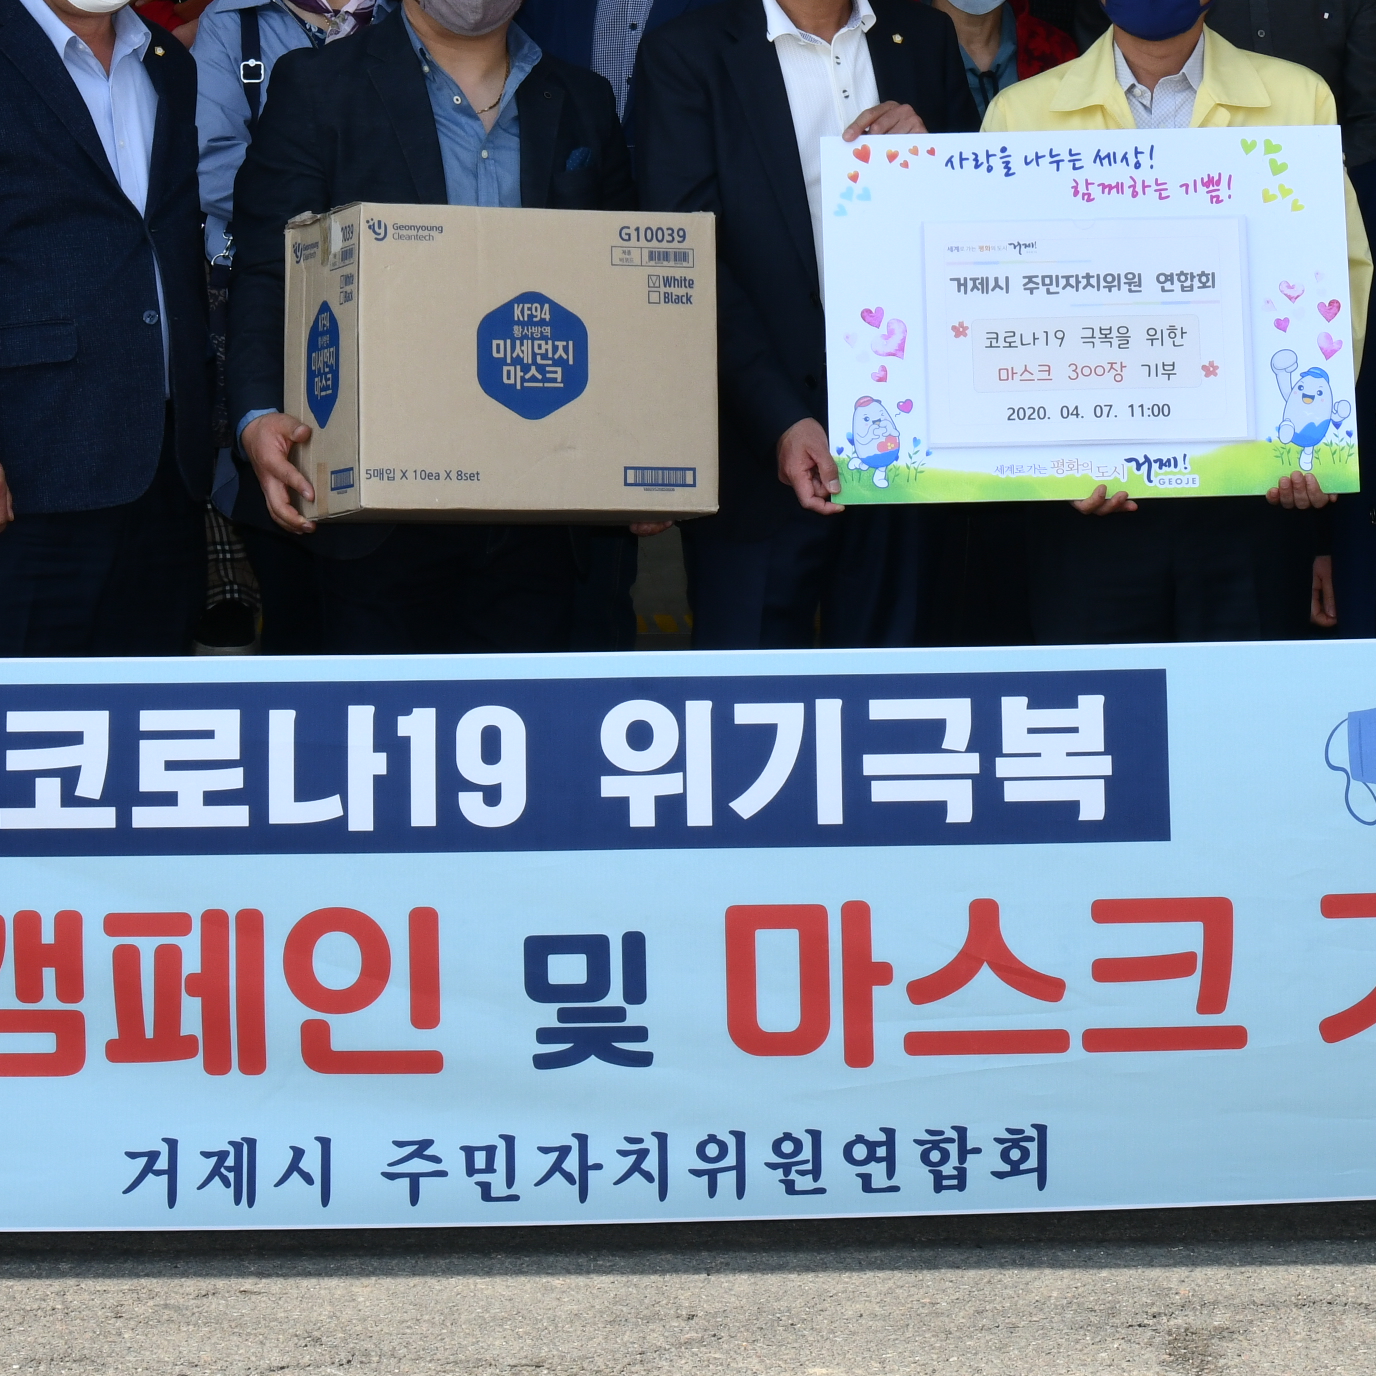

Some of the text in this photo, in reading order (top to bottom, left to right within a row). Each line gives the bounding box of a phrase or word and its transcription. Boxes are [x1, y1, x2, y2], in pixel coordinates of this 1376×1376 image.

[944, 144, 1155, 178] 사랑을 나누는 세상!
[1070, 172, 1233, 205] 함께하는 기쁨!
[392, 222, 444, 234] Geonyoung
[392, 232, 435, 242] Cleantech
[618, 225, 687, 244] G10039
[662, 275, 695, 289] White
[949, 270, 1216, 295] 거제시 주민자치위원 연합회
[663, 291, 693, 305] Black
[514, 303, 551, 322] KF94
[512, 325, 551, 338] 황사방역
[985, 325, 1188, 350] 코로나19 극복을 위한
[311, 345, 336, 375] 미세먼지
[491, 339, 574, 365] 미세먼지
[502, 365, 564, 390] 마스크
[998, 361, 1177, 383] 마스크 300장 기부
[314, 373, 333, 400] 마스크
[1007, 403, 1171, 421] 2020. 04. 07. 11:00
[365, 467, 481, 482] 5매입 X 10ea X 8set
[994, 453, 1188, 484] 세계로 가는 평화의 도시 거제!
[1158, 477, 1197, 486] GEOJE
[600, 694, 1114, 829] 위기극복
[522, 929, 655, 1071] 및
[724, 895, 1249, 1070] 마스크
[121, 1122, 1054, 1210] 거제시 주민자치위원연합회
